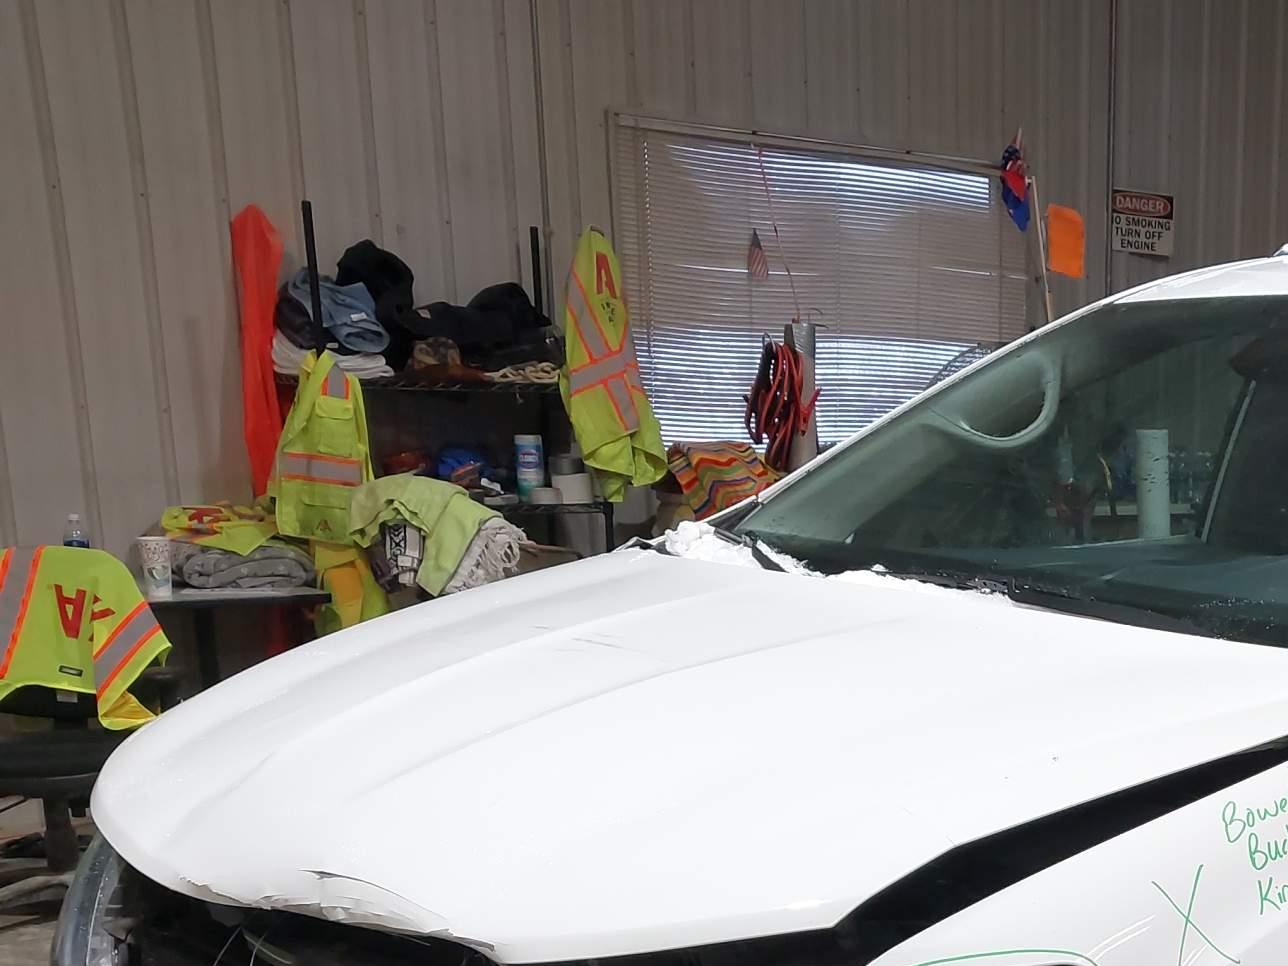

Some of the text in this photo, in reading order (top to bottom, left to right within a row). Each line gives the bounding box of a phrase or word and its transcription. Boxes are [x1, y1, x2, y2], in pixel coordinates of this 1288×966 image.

[1116, 196, 1165, 213] DANGER
[1125, 217, 1171, 231] SMOKING
[1115, 227, 1164, 241] TURN OFF
[1120, 239, 1157, 251] ENGINE
